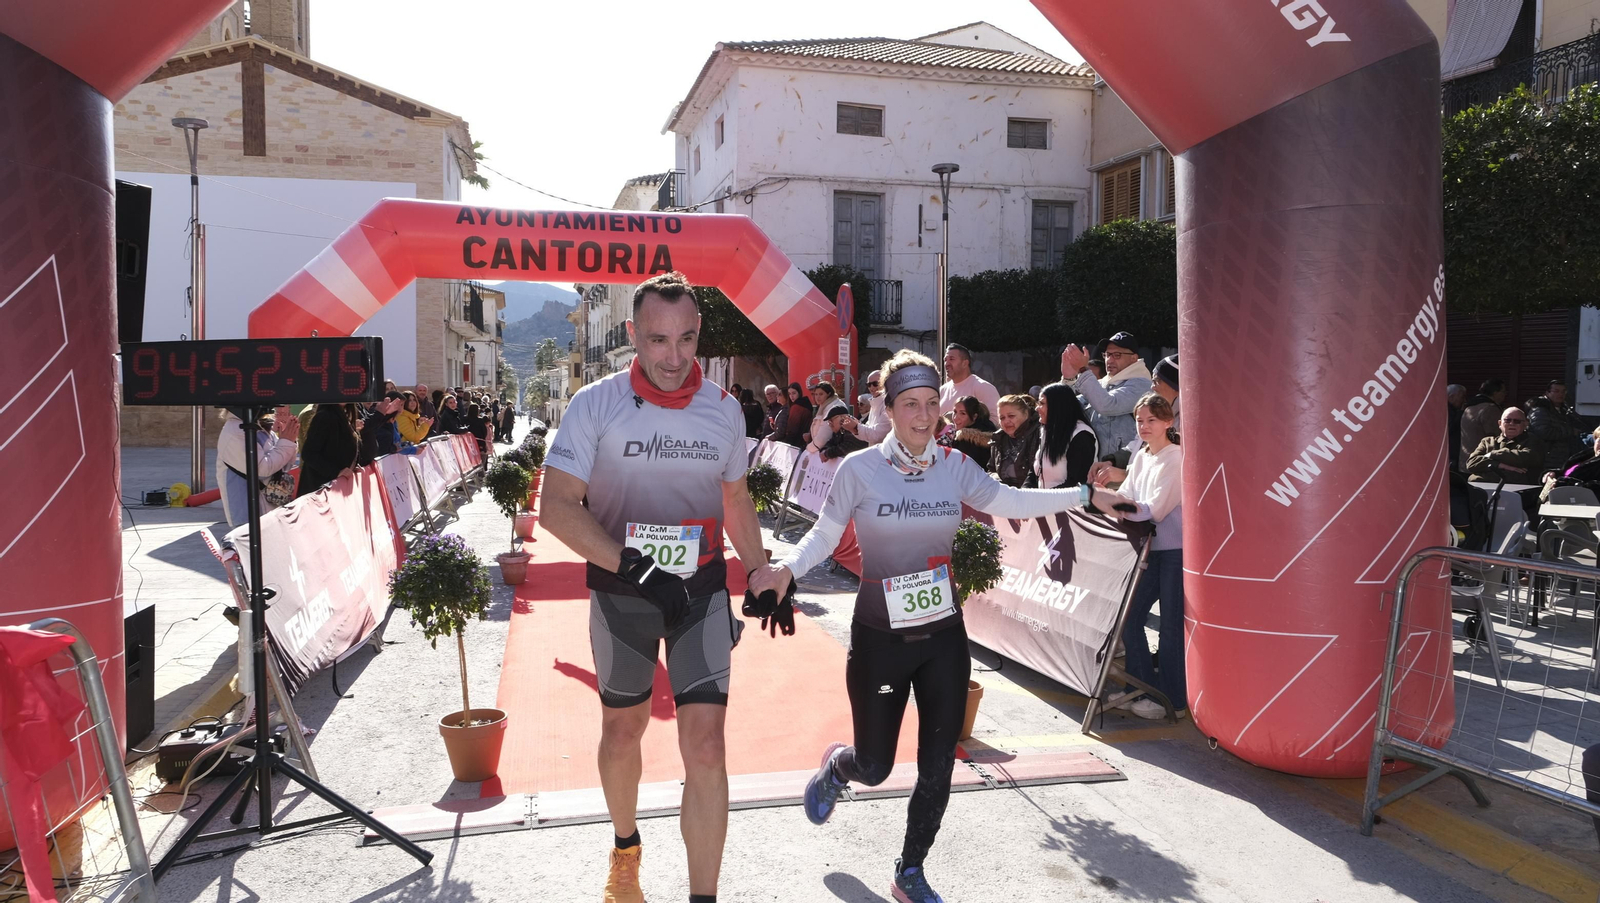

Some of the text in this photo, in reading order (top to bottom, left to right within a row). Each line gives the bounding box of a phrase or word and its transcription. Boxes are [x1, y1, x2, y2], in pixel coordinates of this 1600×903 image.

[1271, 0, 1351, 47] GY
[456, 206, 682, 234] AYUNTAMIENTO
[463, 236, 673, 275] CANTORIA
[1264, 264, 1445, 507] www.teamergy.es
[660, 451, 719, 461] RIO MUNDO
[664, 440, 709, 450] CALAR
[911, 501, 950, 509] CALAR
[928, 509, 959, 517] MUNDO
[642, 543, 687, 566] 202
[903, 574, 919, 582] CxM
[1000, 565, 1090, 614] TEAMERGY
[902, 586, 942, 613] 368
